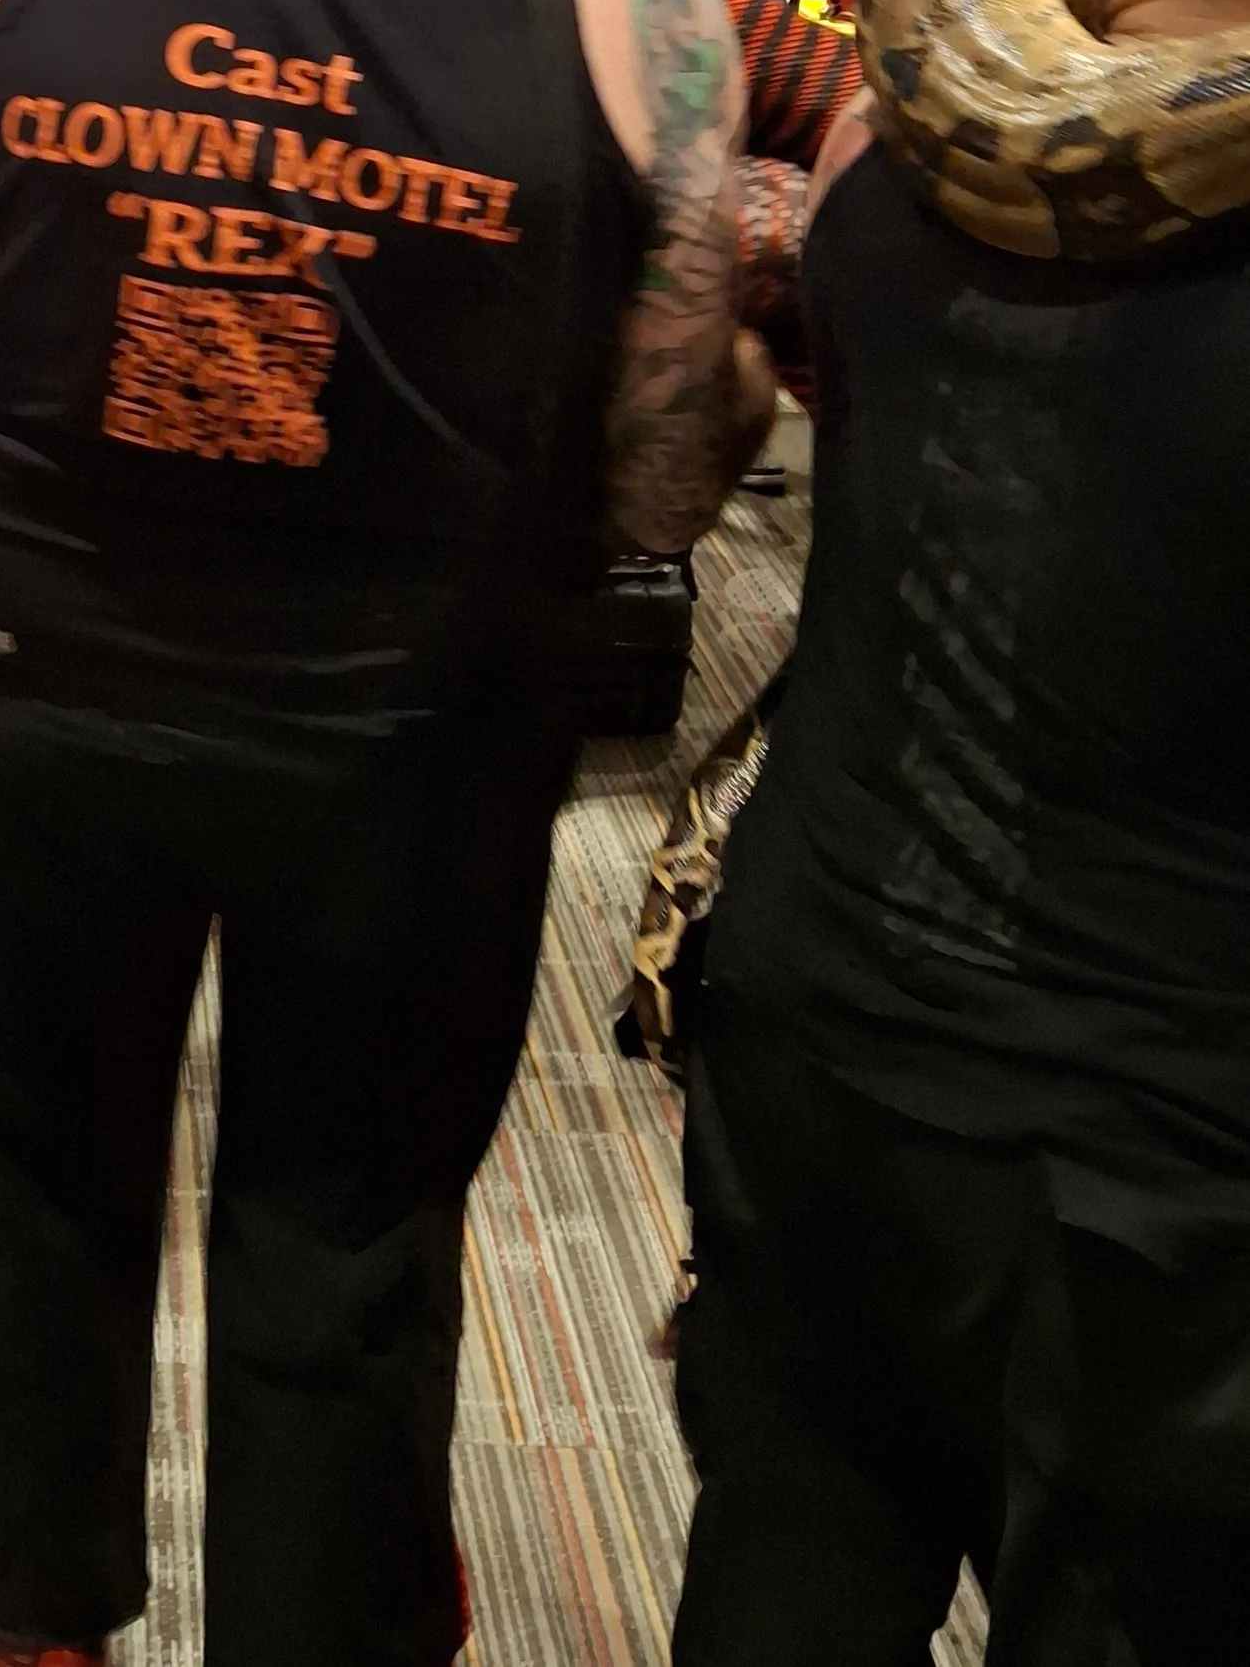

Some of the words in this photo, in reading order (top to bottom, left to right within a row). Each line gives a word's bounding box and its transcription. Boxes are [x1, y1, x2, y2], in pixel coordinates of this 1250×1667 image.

[164, 22, 364, 115] Cast
[1, 94, 264, 182] CLOWN
[268, 127, 523, 243] MOTEL
